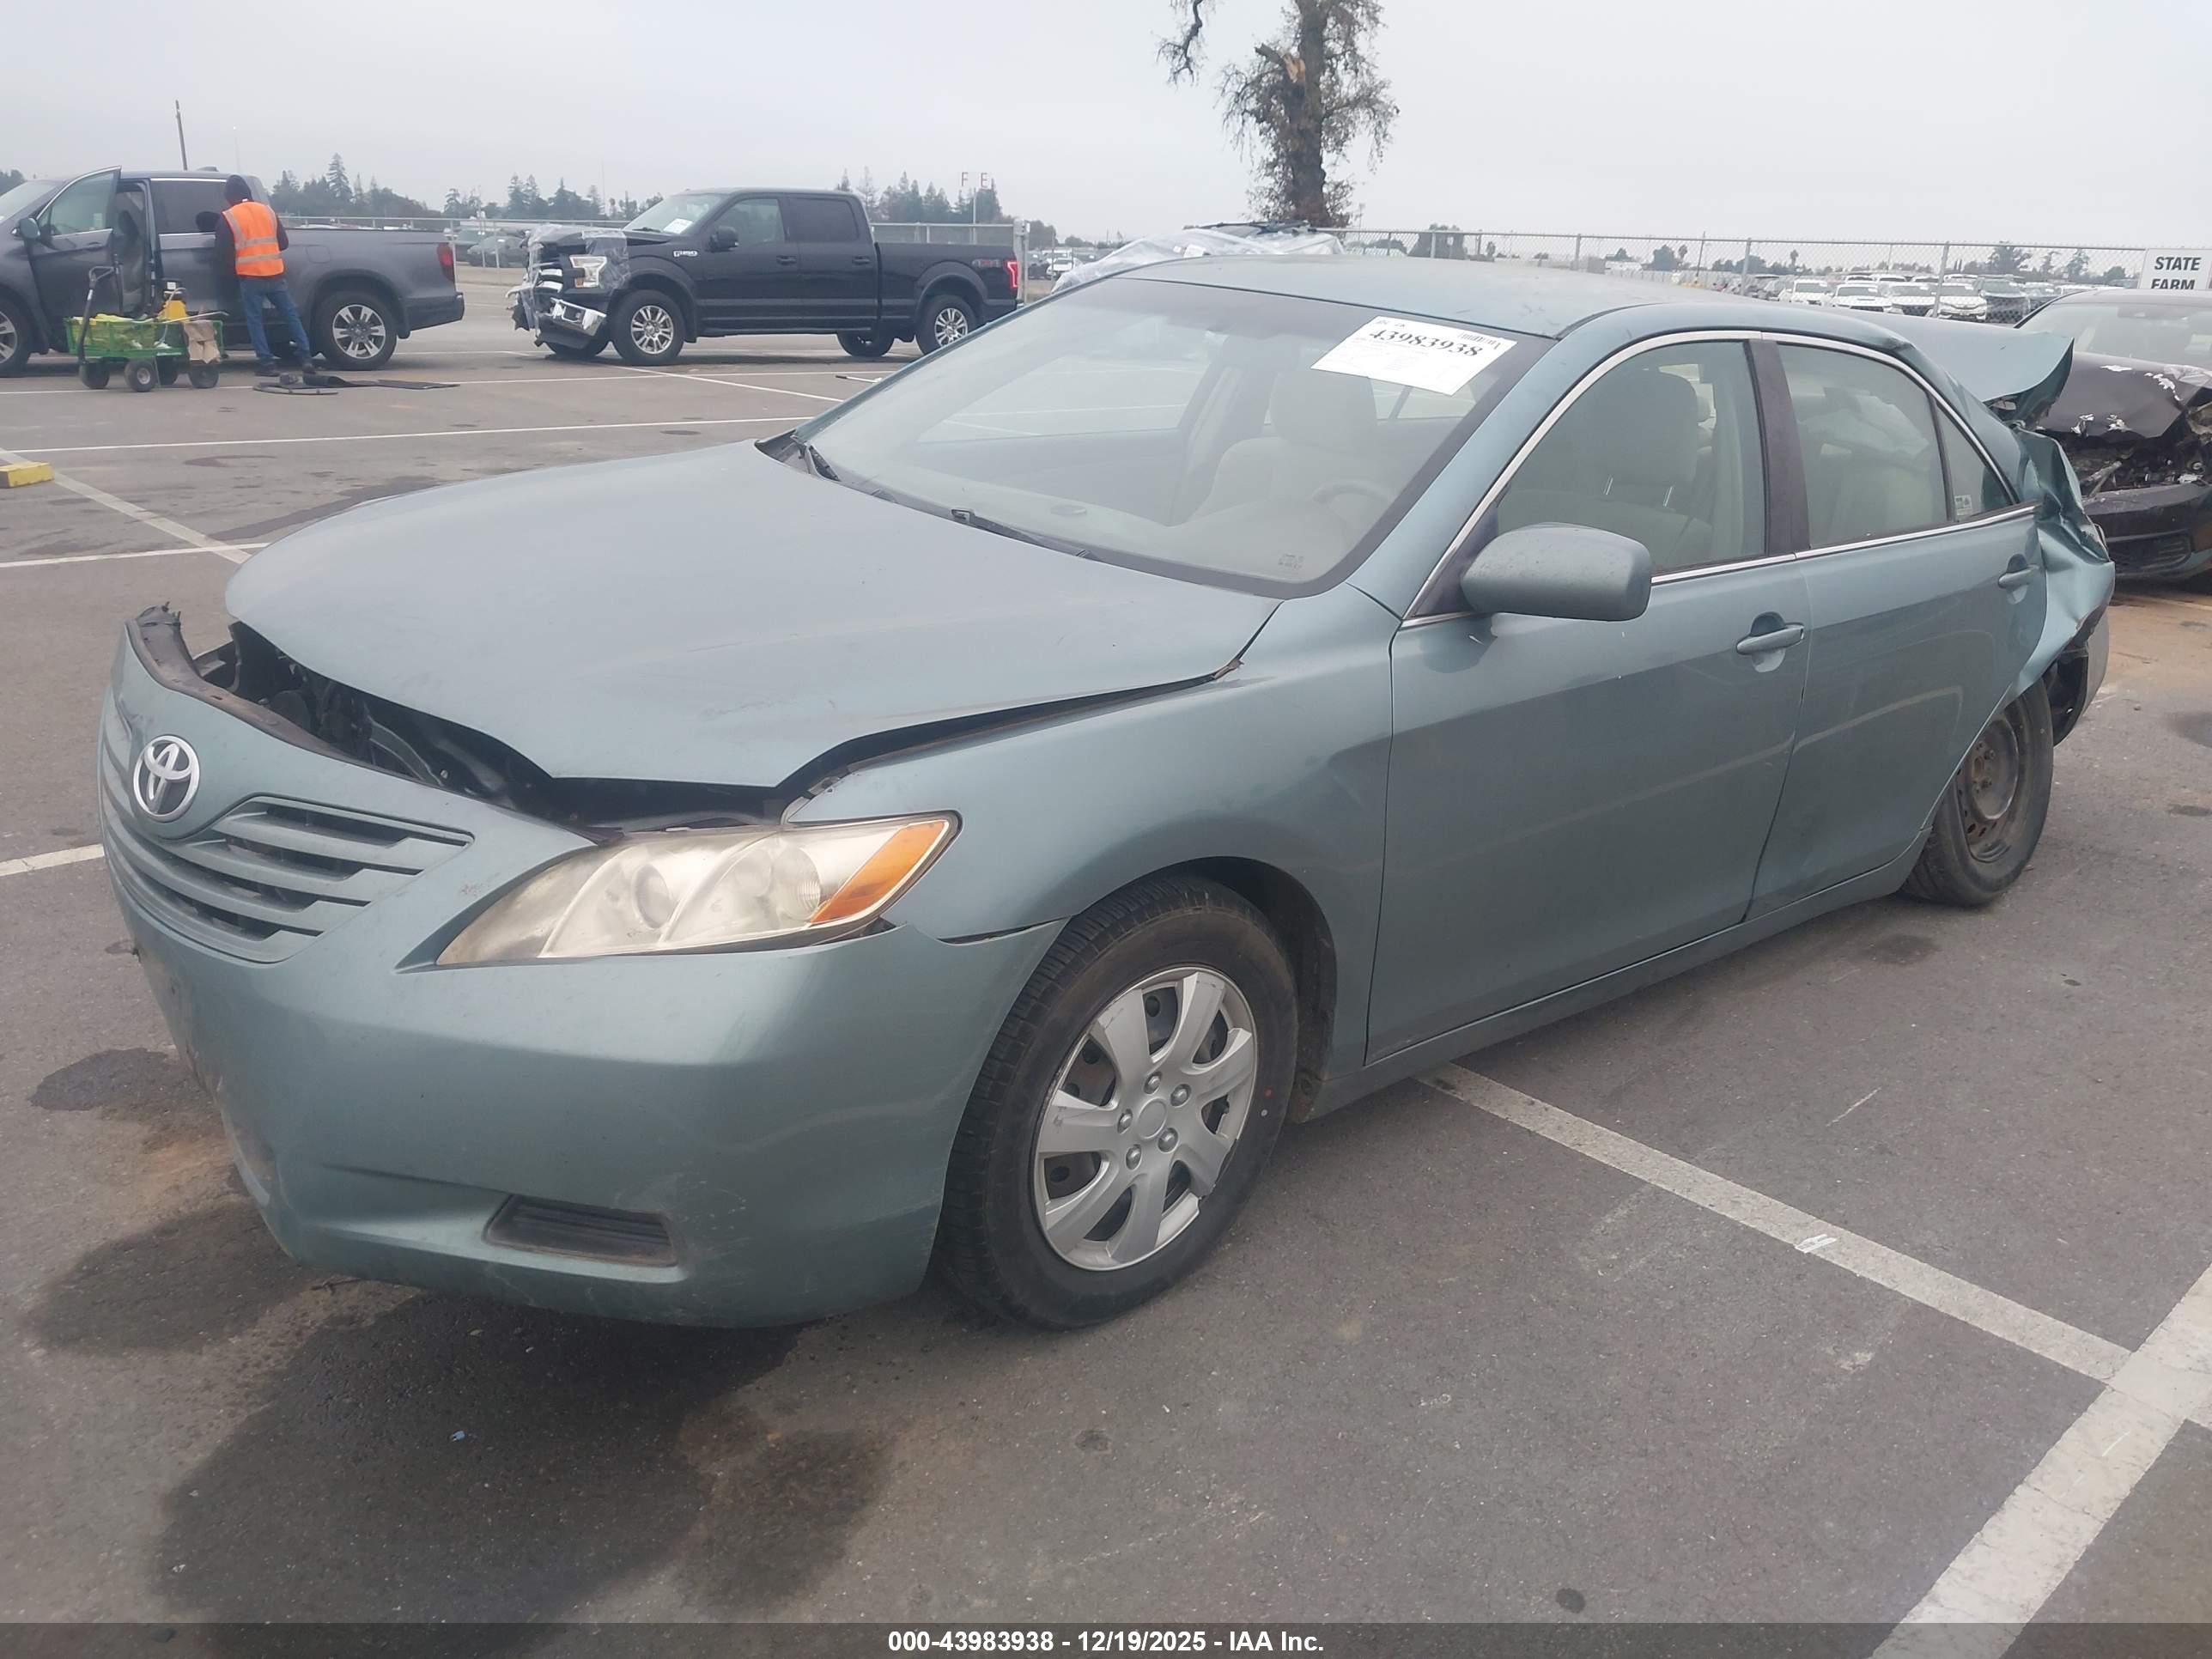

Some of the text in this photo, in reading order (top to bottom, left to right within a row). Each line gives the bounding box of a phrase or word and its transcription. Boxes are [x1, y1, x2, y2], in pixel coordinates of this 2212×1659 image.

[2154, 256, 2202, 270] STATE
[2150, 278, 2196, 290] FARM
[1369, 329, 1484, 356] 43983938
